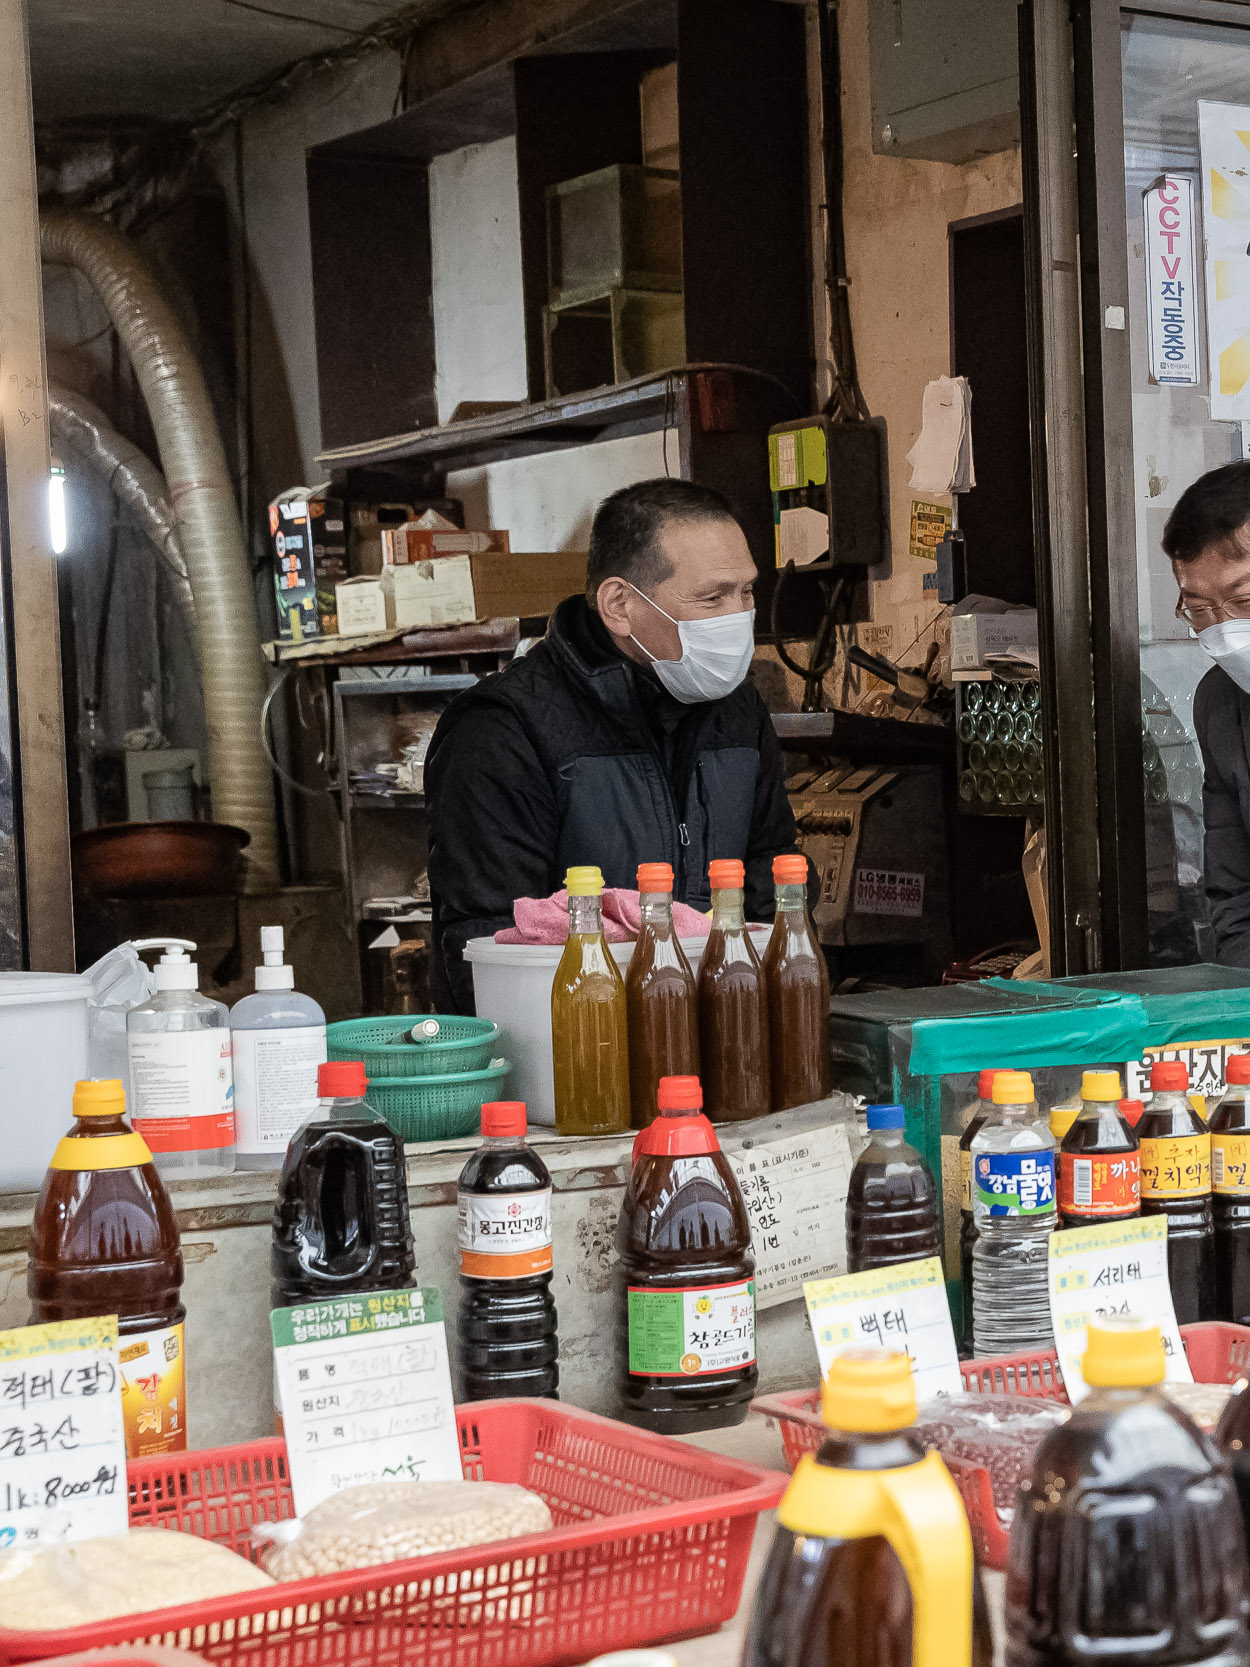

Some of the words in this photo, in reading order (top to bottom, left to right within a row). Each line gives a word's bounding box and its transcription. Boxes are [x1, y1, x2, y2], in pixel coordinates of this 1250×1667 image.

[988, 1173, 1018, 1195] 강남
[1019, 1159, 1053, 1201] 물엿
[479, 1215, 544, 1236] 몽고진간장
[1093, 1260, 1143, 1288] 서리태
[290, 1301, 364, 1325] 우리가게는
[367, 1290, 424, 1314] 원산지를
[293, 1319, 348, 1343] 정직하게
[349, 1307, 427, 1332] 표시했습니다
[302, 1395, 341, 1413] 원산지
